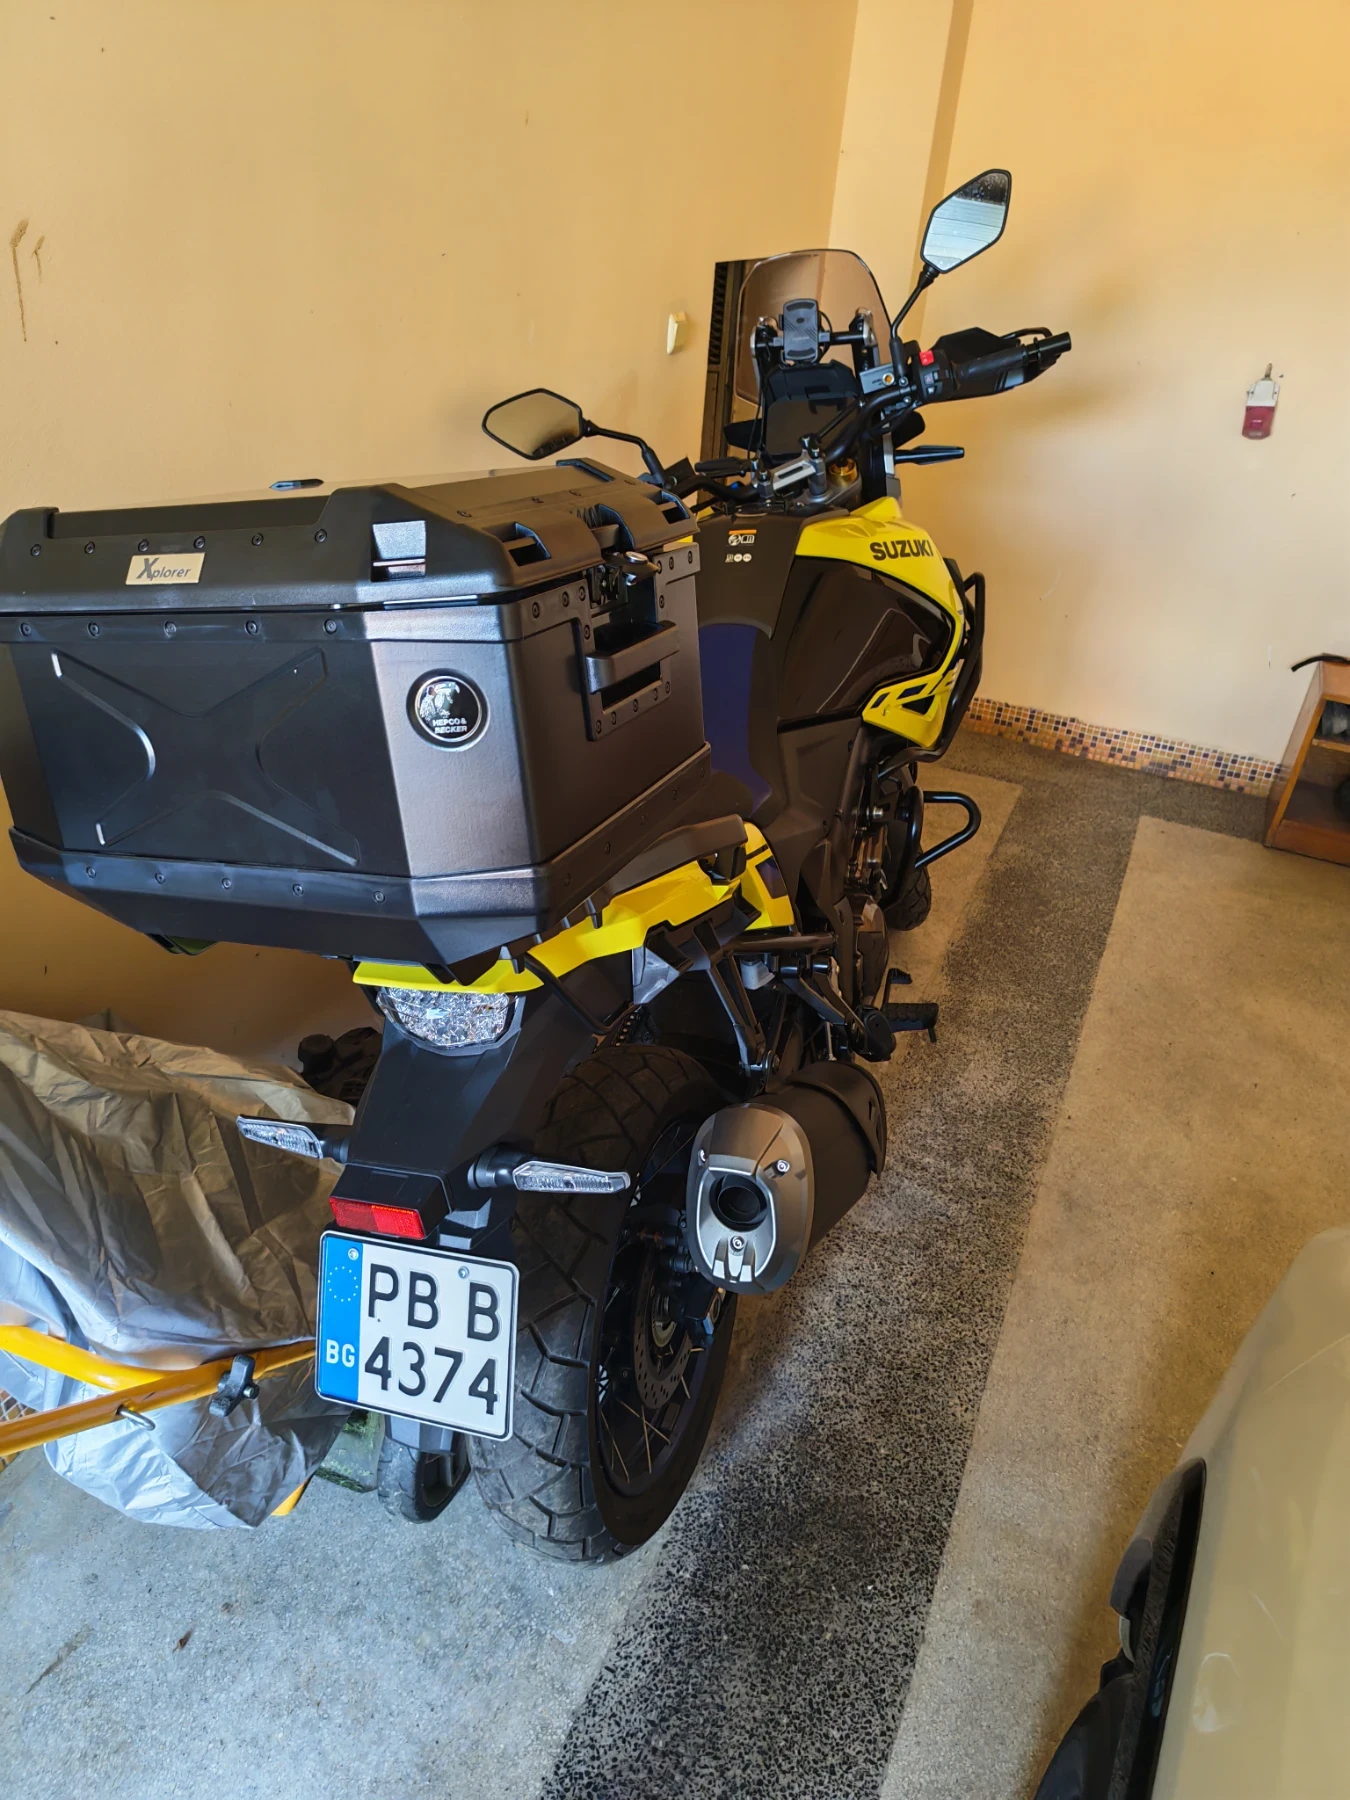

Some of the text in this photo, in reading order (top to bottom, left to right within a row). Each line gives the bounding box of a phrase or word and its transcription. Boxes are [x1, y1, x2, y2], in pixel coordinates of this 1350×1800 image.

[869, 539, 934, 561] SUZUKI
[136, 557, 192, 581] Xplorer
[432, 717, 467, 726] HEPCO &
[434, 725, 467, 734] BECKER
[326, 1339, 355, 1367] BG
[364, 1336, 498, 1415] 4374
